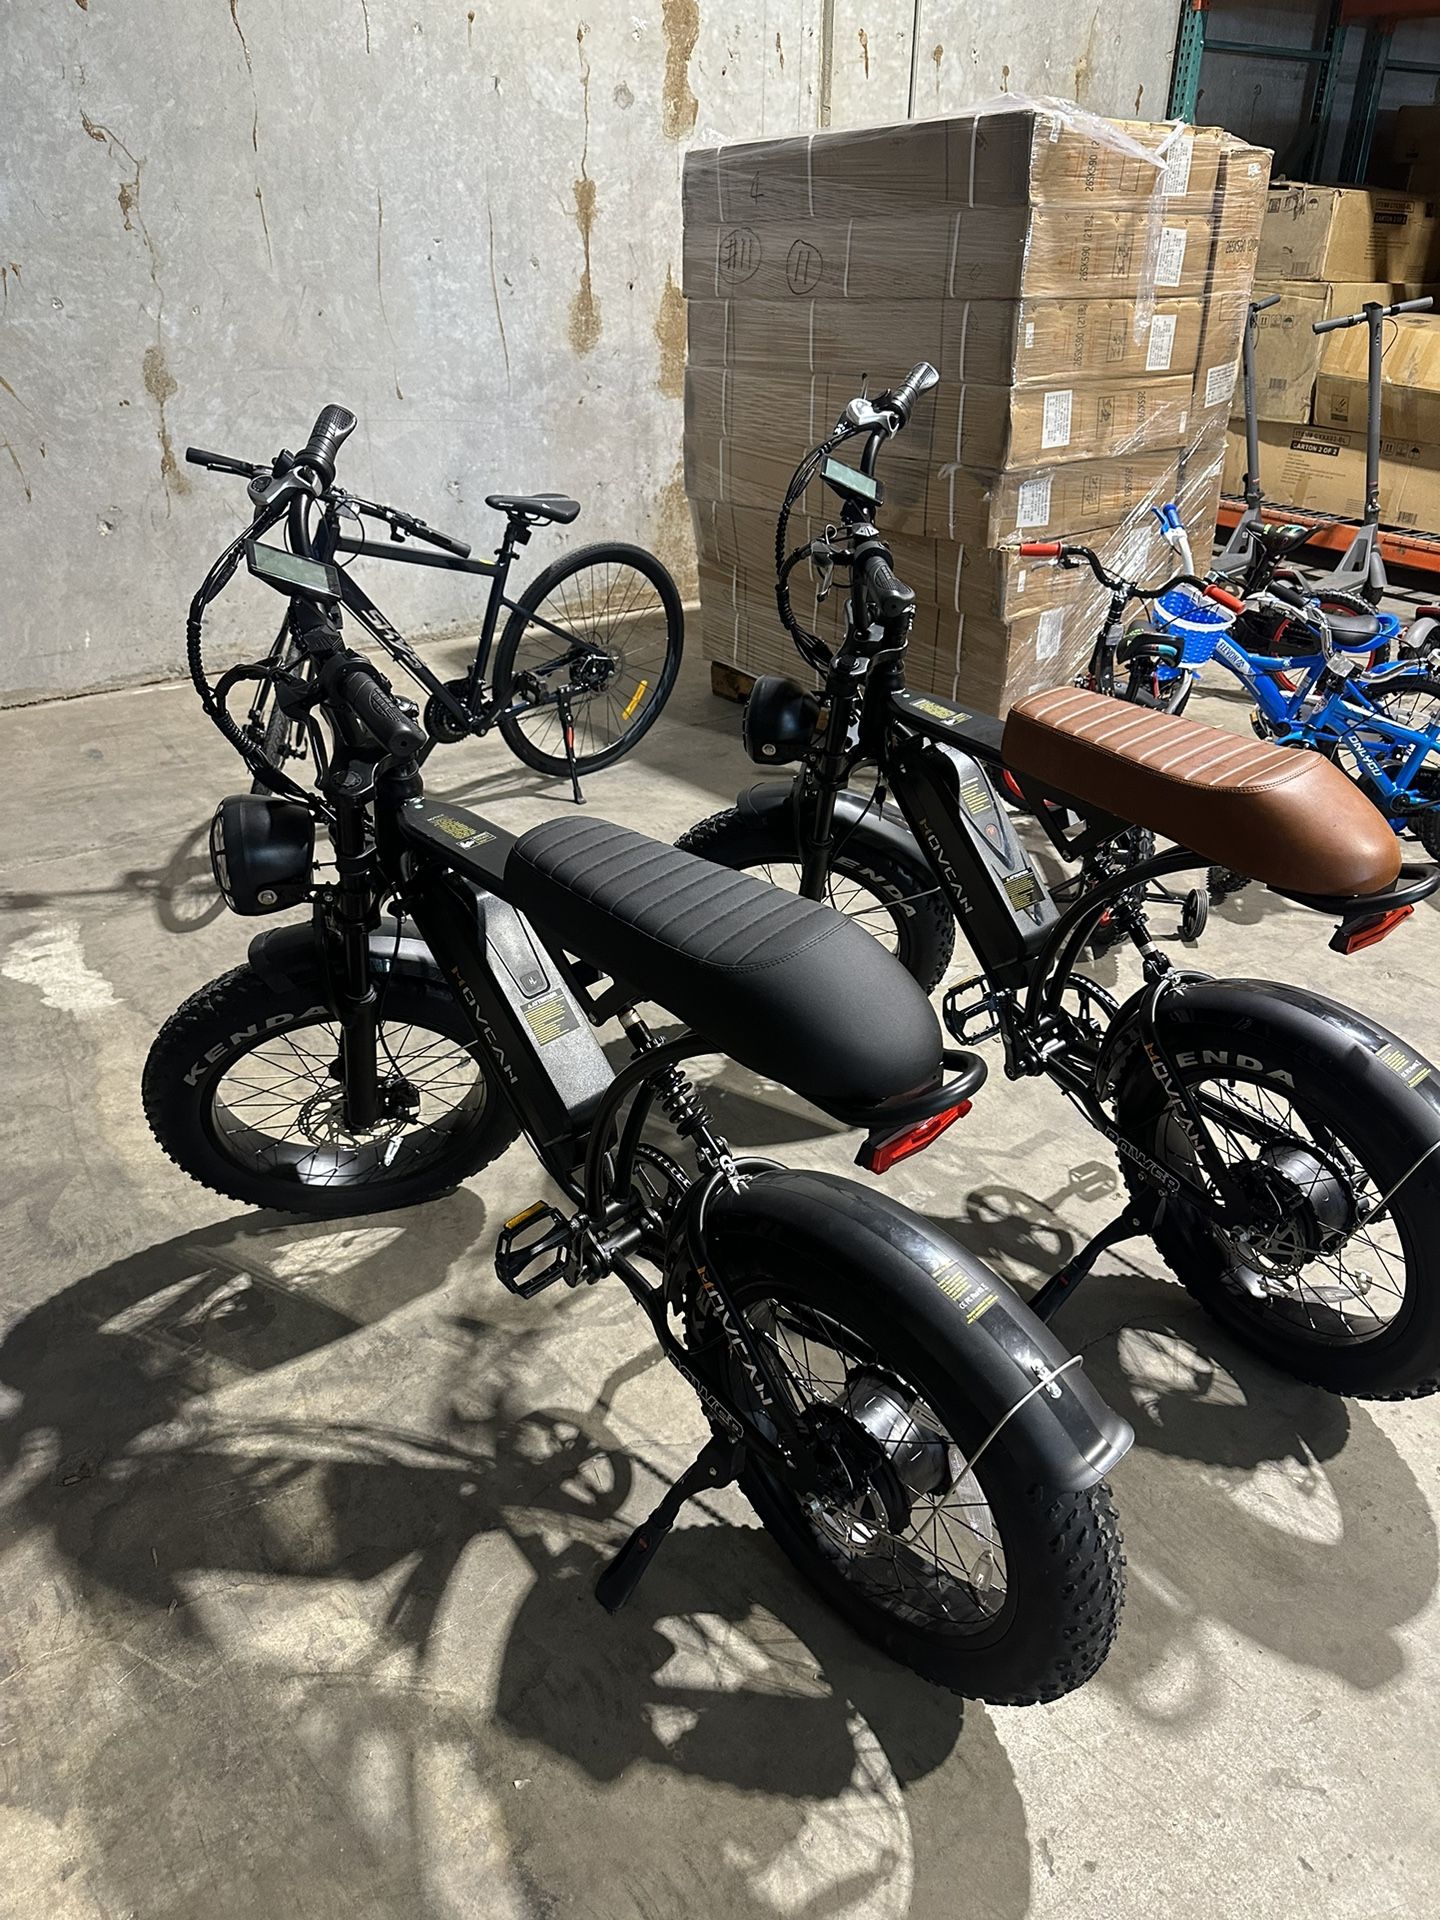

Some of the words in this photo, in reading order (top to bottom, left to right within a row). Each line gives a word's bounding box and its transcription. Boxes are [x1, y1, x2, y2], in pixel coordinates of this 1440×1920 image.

[1292, 441, 1317, 452] CARTON
[834, 855, 917, 919] ENDA
[918, 816, 974, 915] MOVCAN
[182, 1004, 332, 1088] KENDA
[450, 964, 520, 1086] MOVCAN
[1176, 1049, 1297, 1089] ENDA
[1103, 1126, 1181, 1193] POWER
